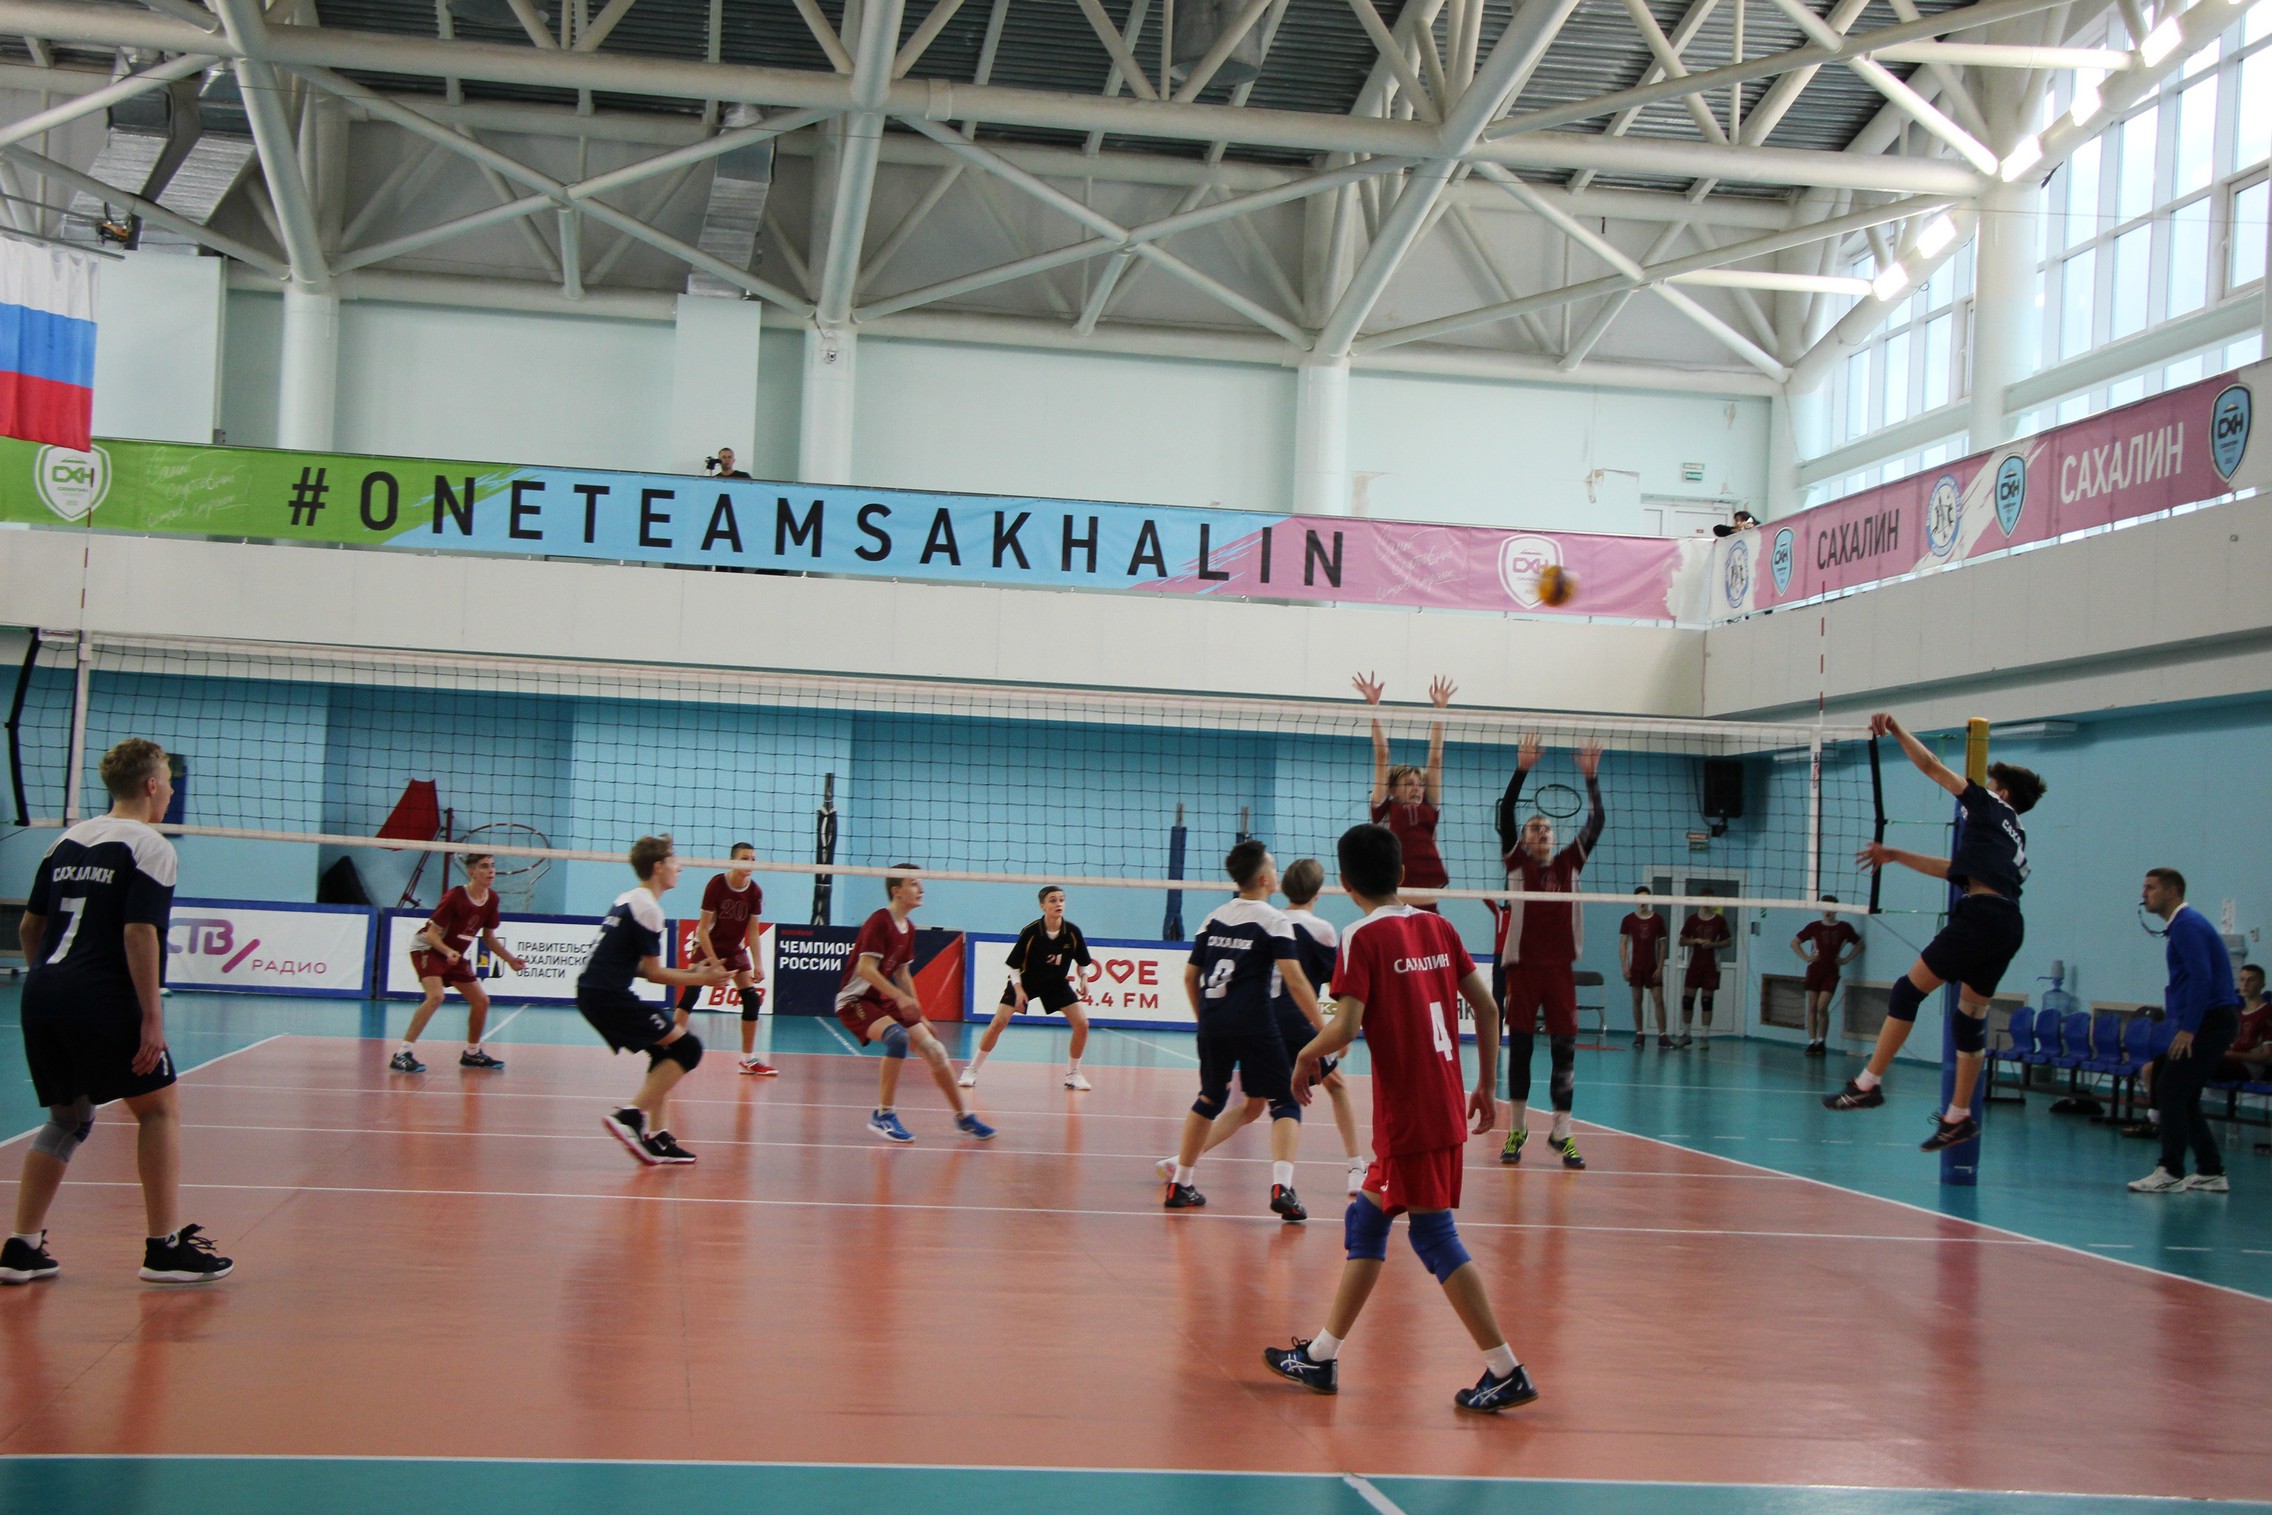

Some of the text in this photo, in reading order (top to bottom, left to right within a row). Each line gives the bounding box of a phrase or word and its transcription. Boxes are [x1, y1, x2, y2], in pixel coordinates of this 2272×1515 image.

[2060, 421, 2184, 504] САХАЛИН
[288, 466, 1343, 588] #ONETEAMSAKHALIN
[1817, 509, 1899, 570] САХАЛИН
[718, 899, 750, 921] 20
[46, 897, 87, 964] 7
[252, 960, 327, 976] РАДИО
[779, 956, 842, 972] РОССИИ
[1045, 953, 1063, 966] 21
[1394, 953, 1450, 974] САХАЛИН
[1123, 992, 1159, 1009] FM
[649, 1013, 667, 1030] 3
[1430, 1001, 1453, 1062] 4
